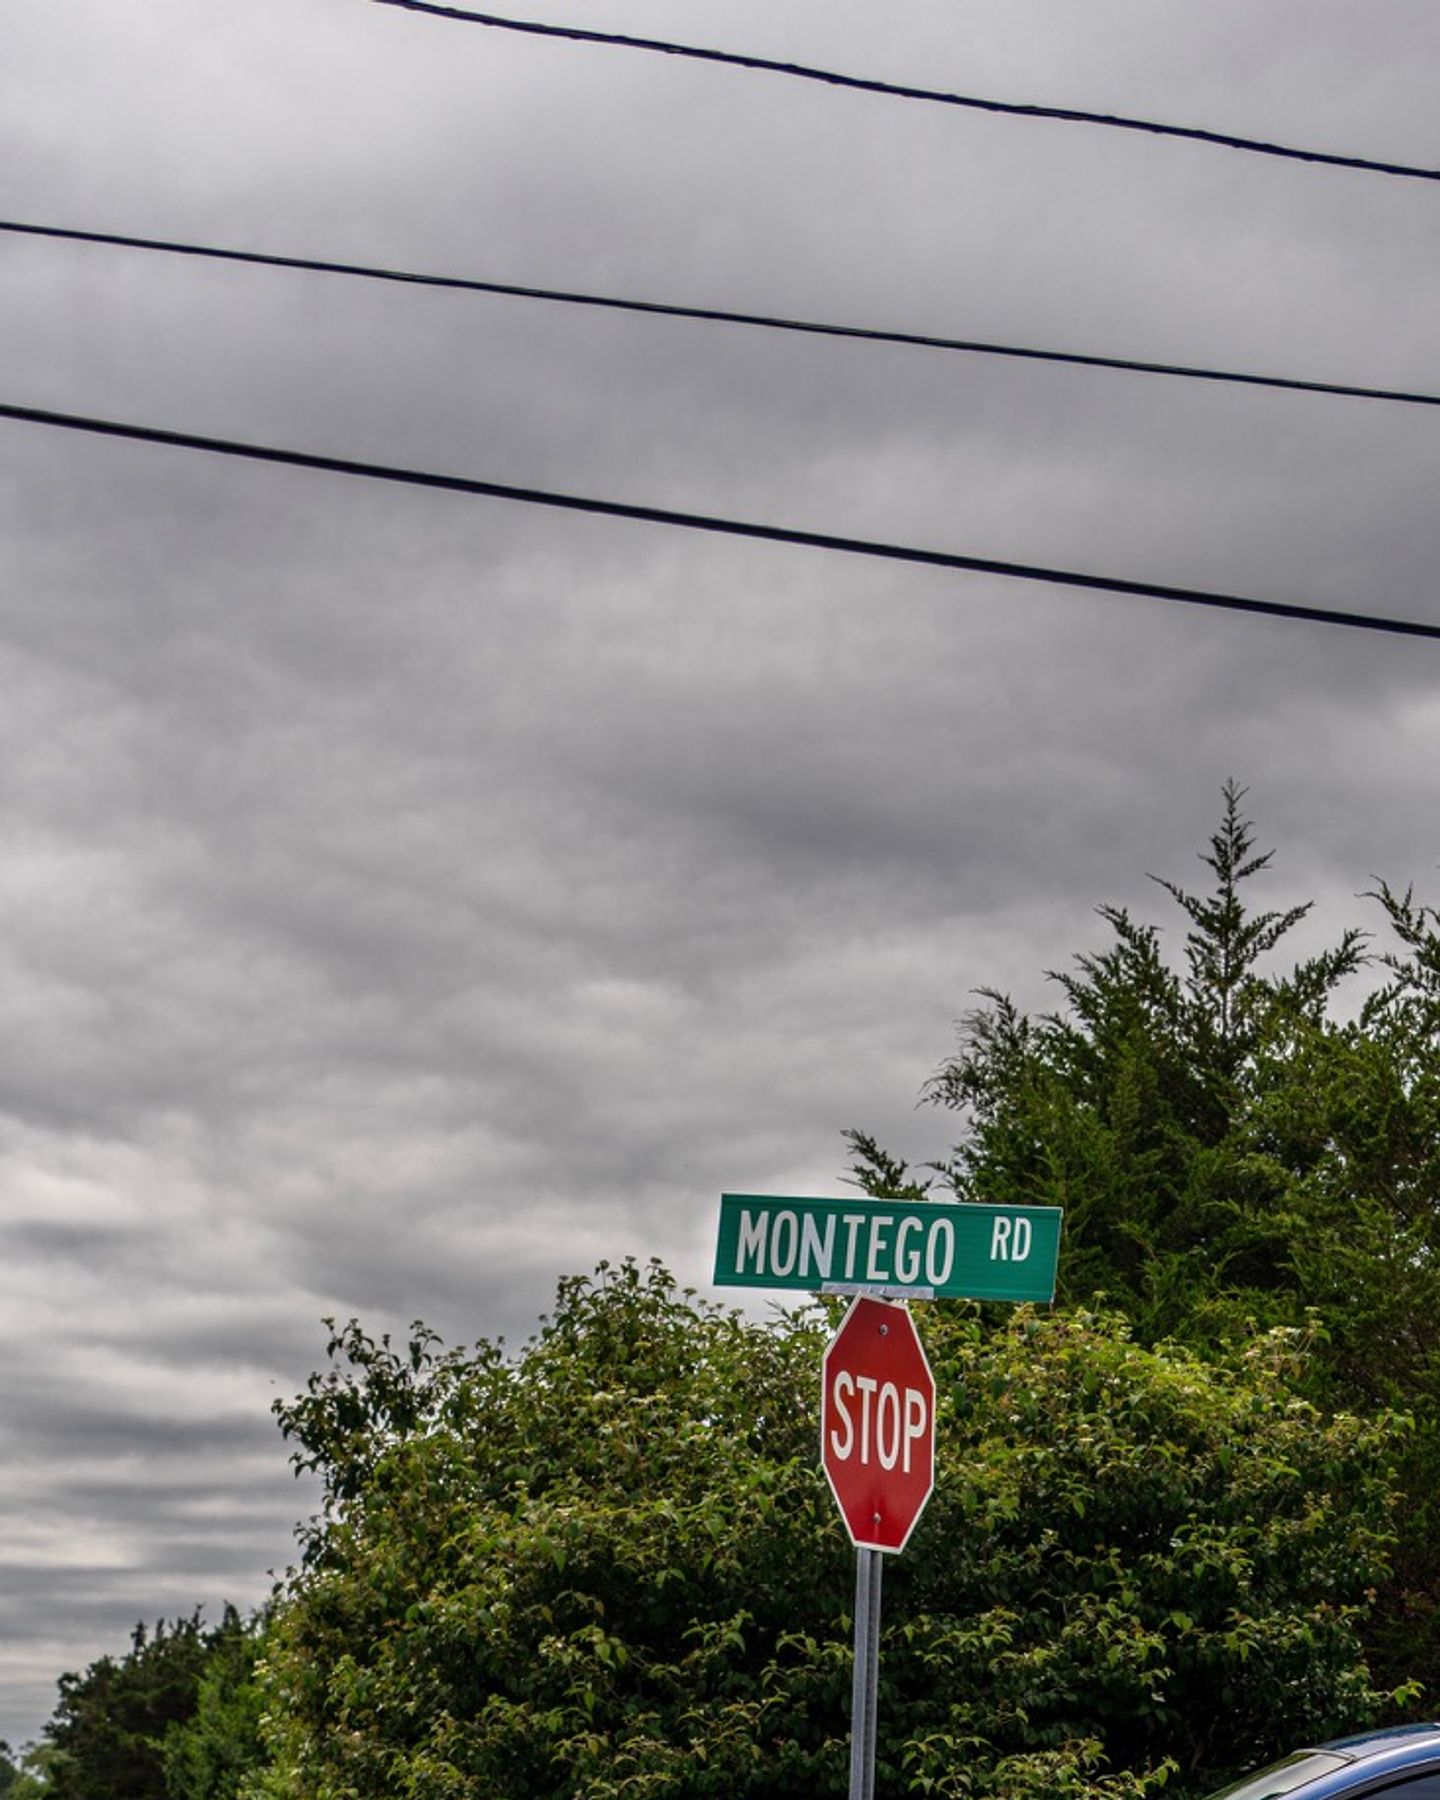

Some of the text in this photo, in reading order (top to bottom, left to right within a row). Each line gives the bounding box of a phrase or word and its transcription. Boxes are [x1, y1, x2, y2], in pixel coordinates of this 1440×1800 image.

[735, 1210, 1032, 1285] MONTEGO RD
[831, 1371, 926, 1473] STOP
